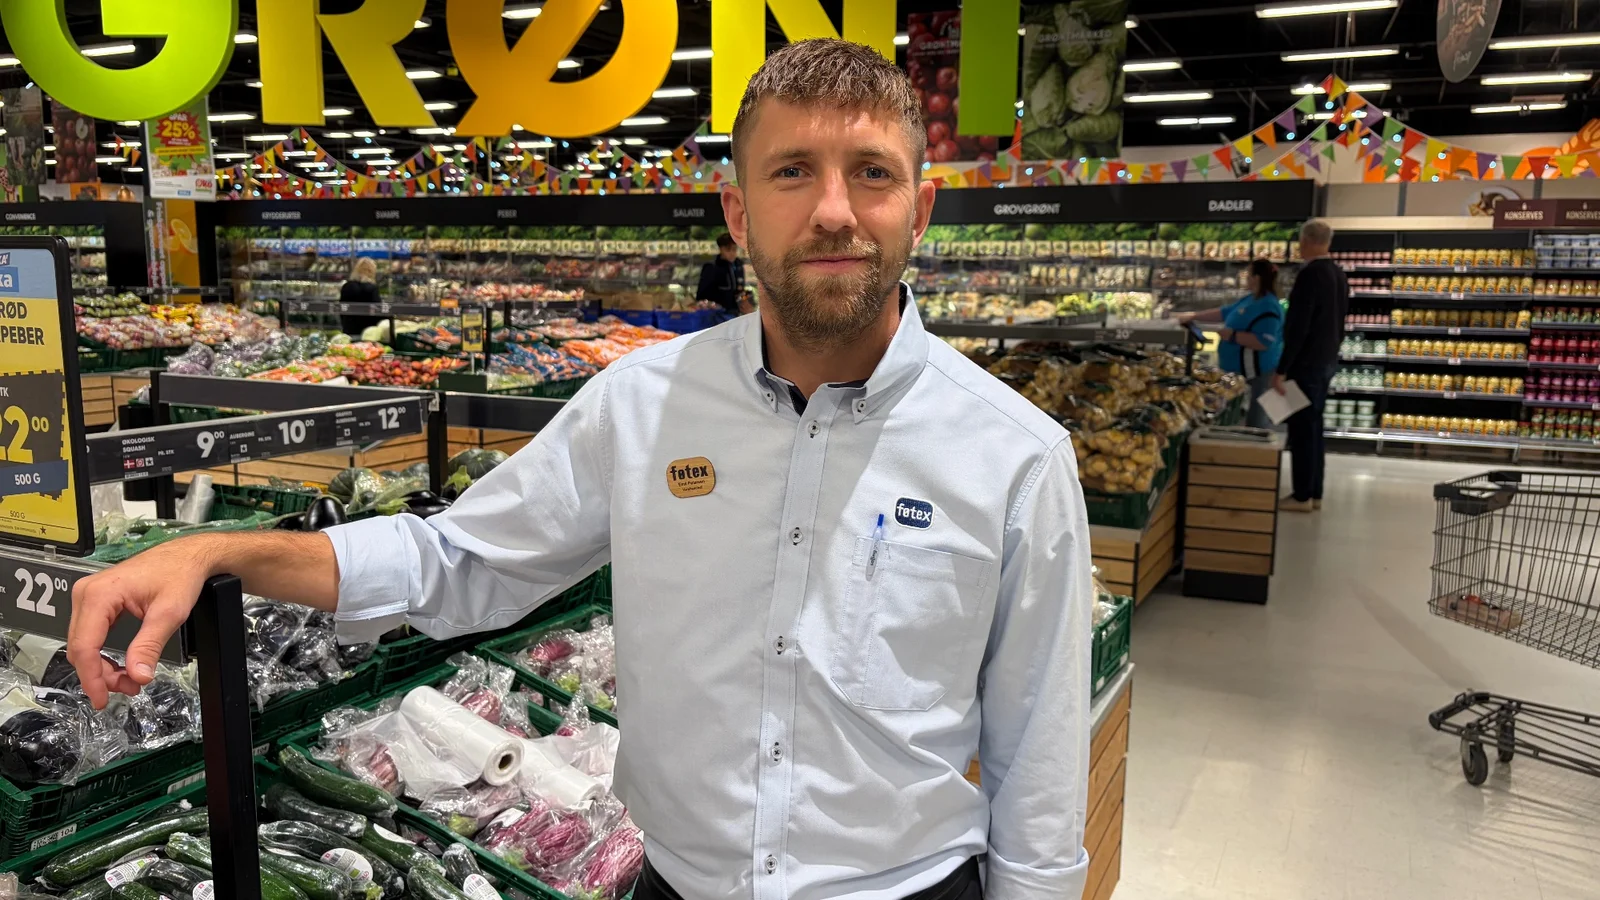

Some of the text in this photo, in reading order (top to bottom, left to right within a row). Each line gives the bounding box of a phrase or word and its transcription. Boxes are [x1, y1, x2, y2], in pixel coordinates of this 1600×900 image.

[161, 120, 196, 139] 25%
[994, 203, 1061, 216] GROVGRØNT
[1208, 199, 1253, 212] DADLER
[1504, 211, 1544, 221] KONSERVES
[0, 325, 45, 346] PEBER
[377, 406, 400, 430] 12
[0, 405, 33, 464] 2
[121, 436, 155, 445] ØKOLOGISK
[229, 431, 255, 440] AUBERGINE
[278, 419, 306, 445] 10
[122, 445, 146, 453] SQUASH
[196, 431, 215, 459] 9
[14, 472, 41, 485] 500 G
[669, 464, 709, 481] føtex
[9, 510, 20, 519] 500
[896, 503, 932, 522] føtex
[14, 567, 68, 617] 22 00
